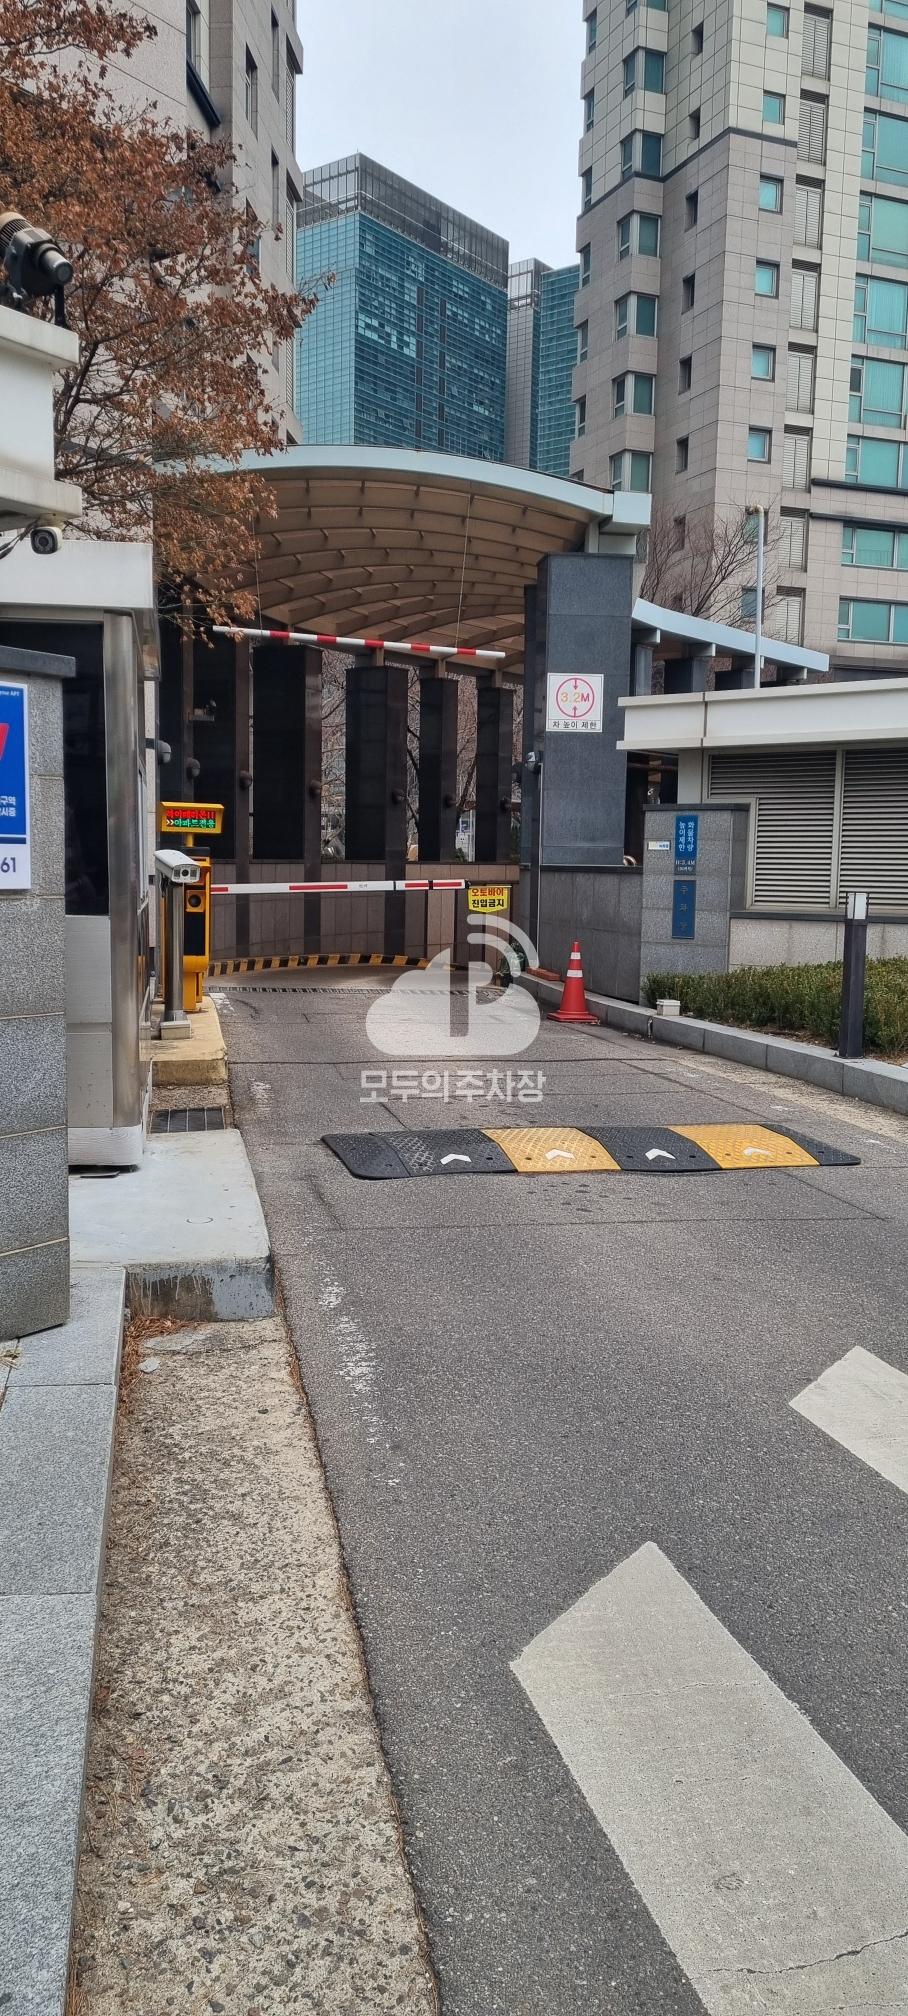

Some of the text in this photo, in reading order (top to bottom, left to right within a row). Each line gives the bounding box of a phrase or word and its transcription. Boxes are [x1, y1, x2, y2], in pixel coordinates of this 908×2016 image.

[561, 692, 590, 703] 3.2M
[552, 721, 597, 730] 차 높이 제한
[0, 795, 16, 806] 구역
[0, 807, 16, 817] 시중
[678, 821, 686, 852] 높이제한
[686, 821, 695, 852] 화물차량
[471, 888, 504, 897] 오토바이
[472, 899, 505, 908] 진입금지
